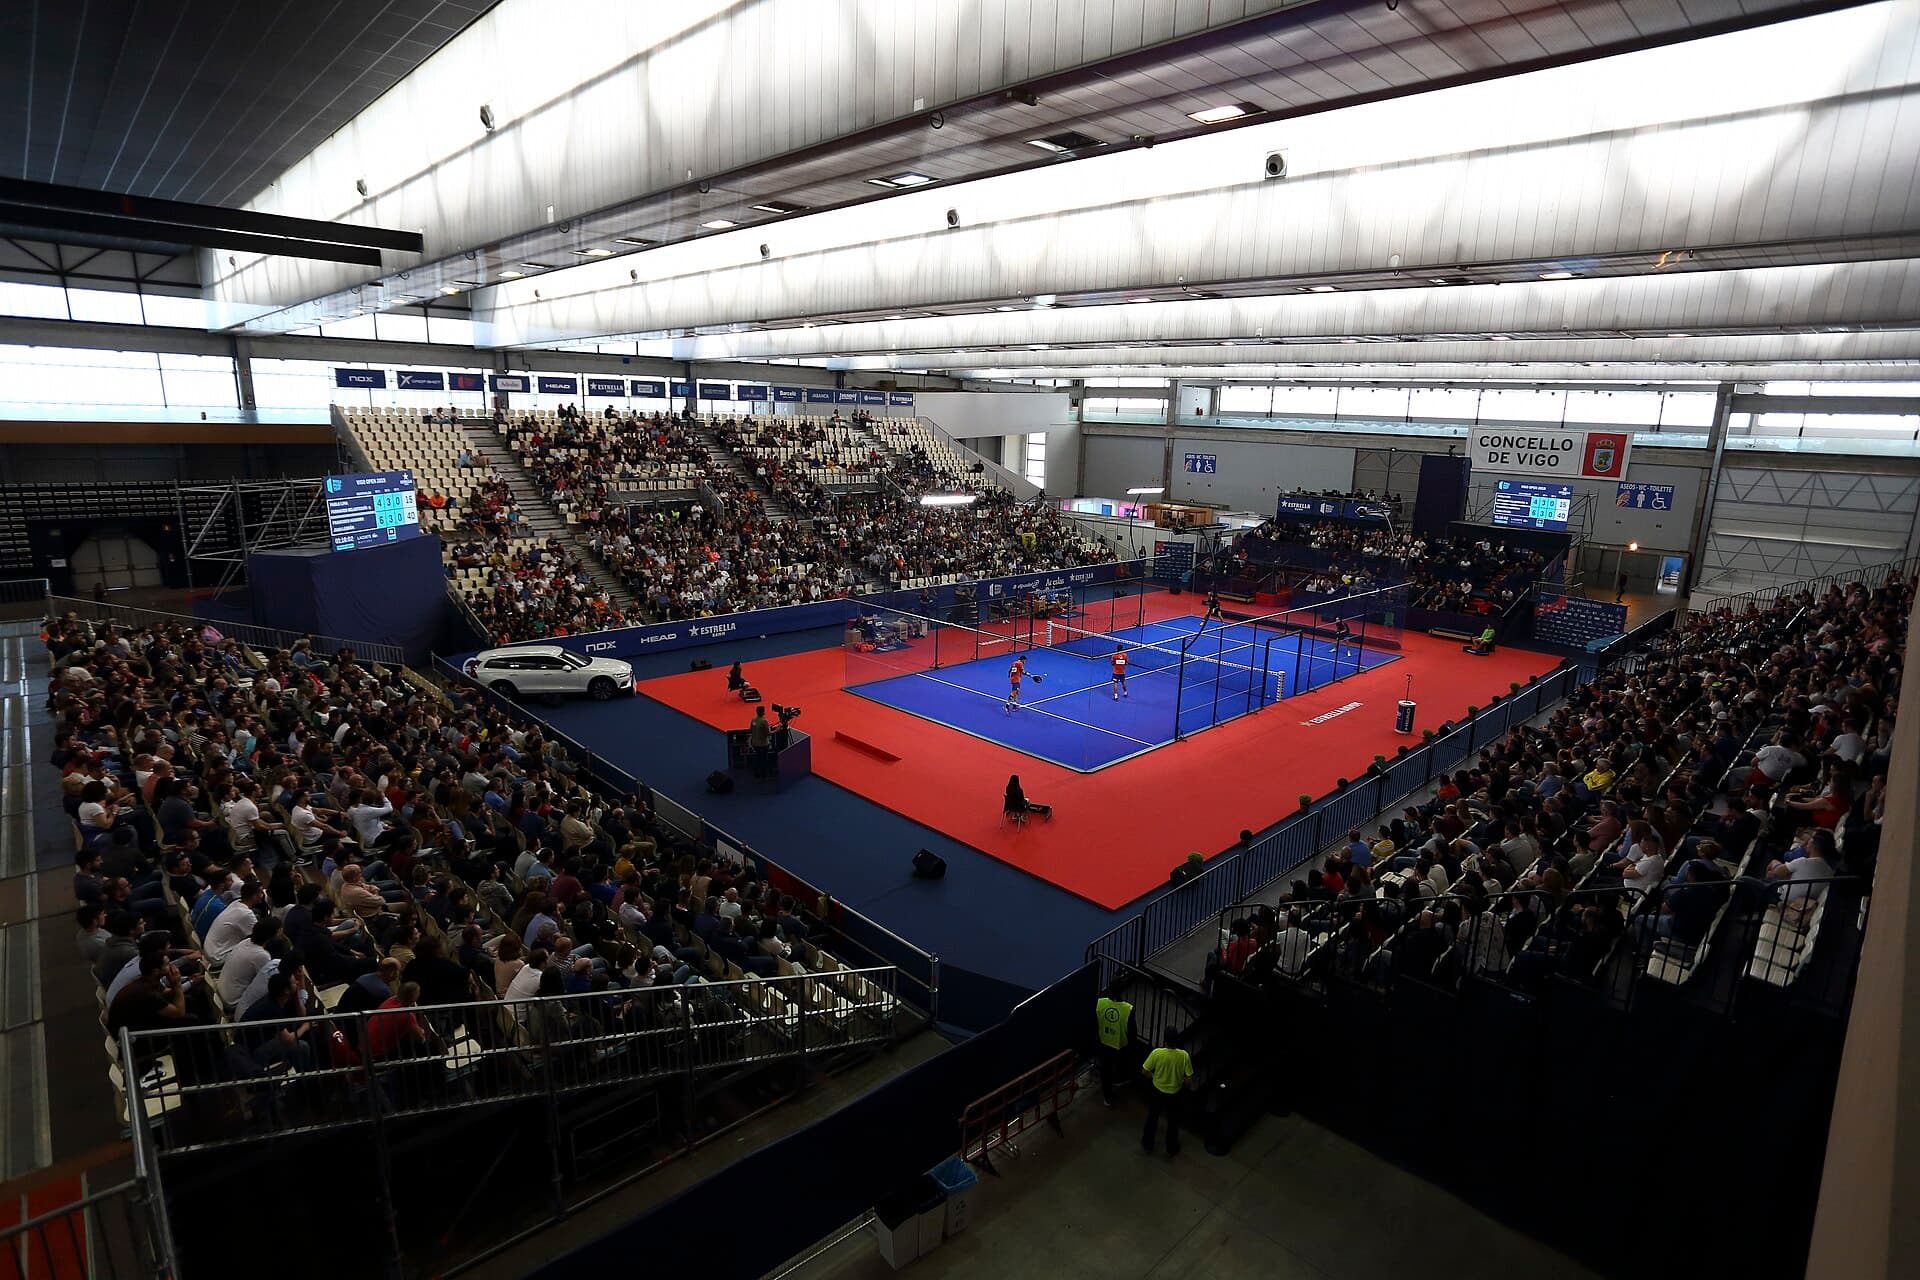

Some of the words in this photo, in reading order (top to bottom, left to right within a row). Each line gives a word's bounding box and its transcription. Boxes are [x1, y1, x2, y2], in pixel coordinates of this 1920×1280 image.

[1479, 435, 1574, 451] CONCELLO
[1488, 451, 1511, 464] DE
[1516, 452, 1560, 467] VIGO
[376, 497, 382, 506] 4
[386, 497, 392, 506] 3
[395, 496, 401, 505] 0
[405, 495, 413, 504] 15
[379, 515, 385, 525] 6
[388, 514, 394, 523] 3
[397, 513, 403, 522] 0
[406, 511, 416, 521] 40
[700, 622, 737, 635] ESTRELLA
[640, 632, 678, 644] HEAD
